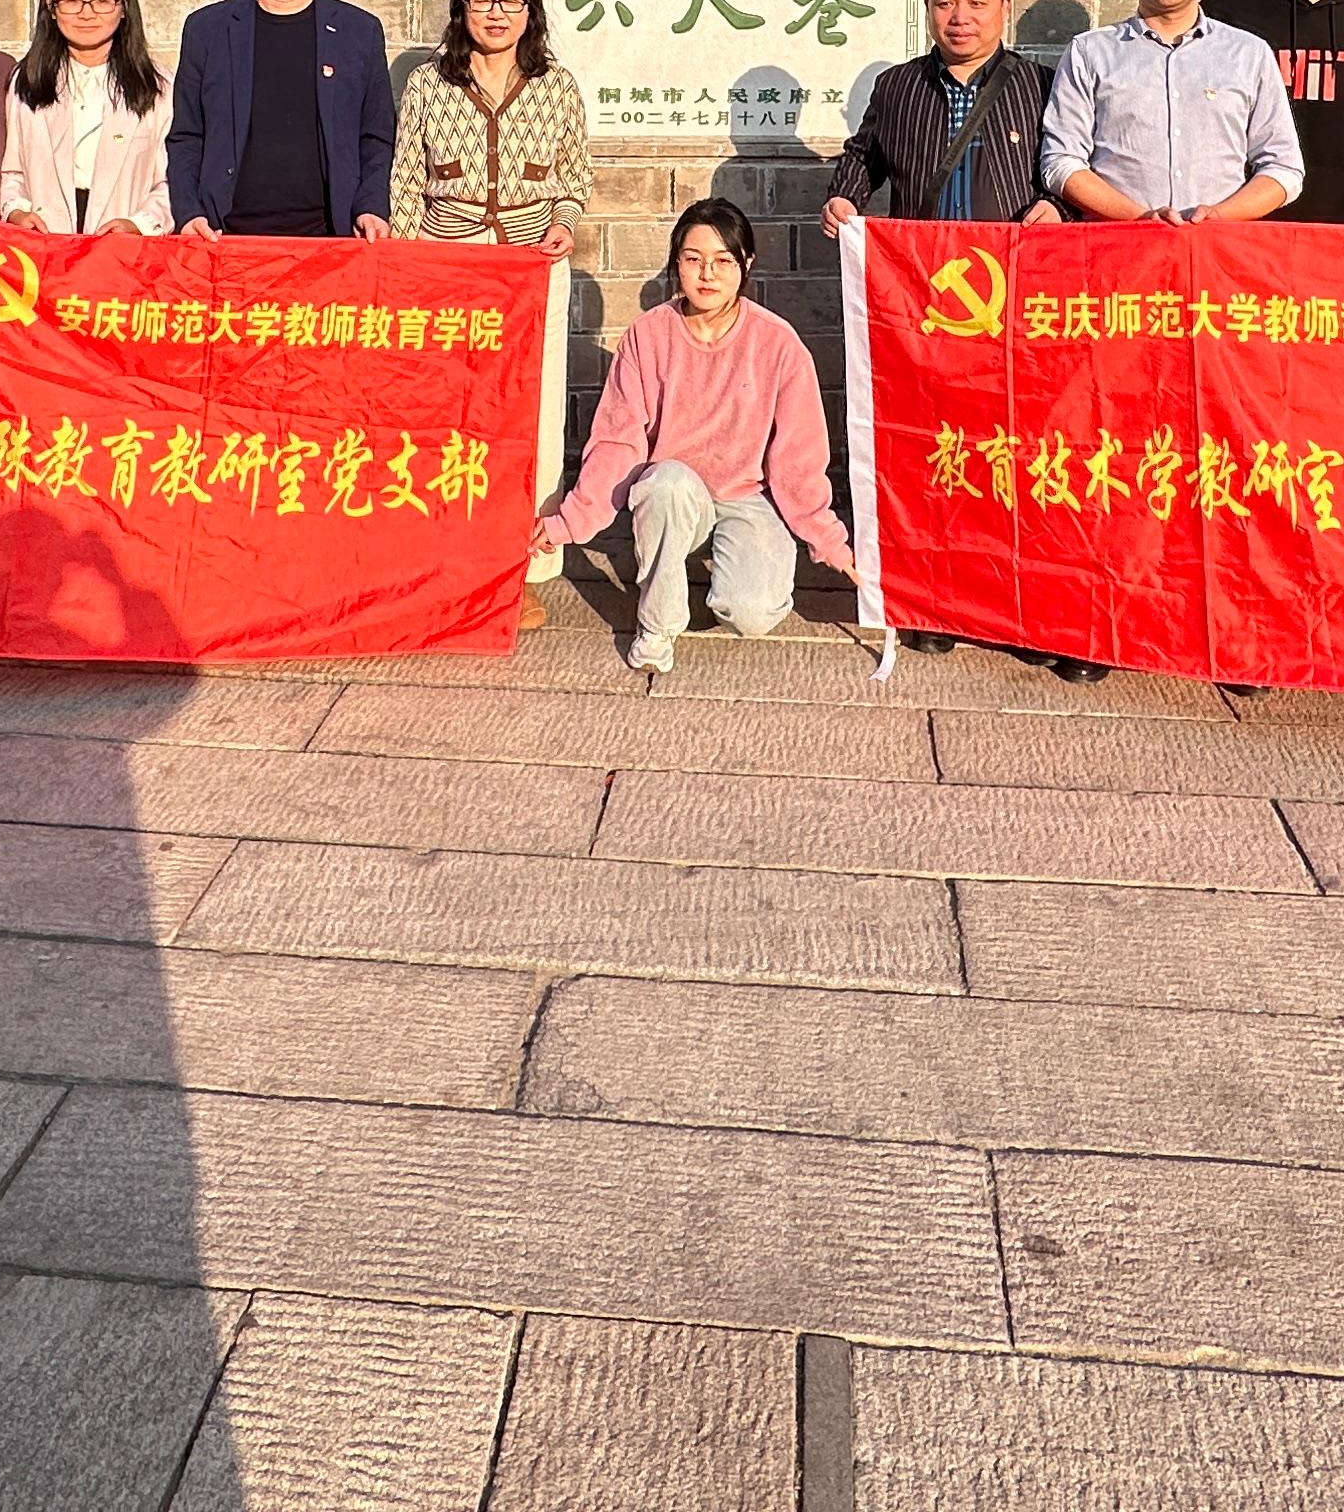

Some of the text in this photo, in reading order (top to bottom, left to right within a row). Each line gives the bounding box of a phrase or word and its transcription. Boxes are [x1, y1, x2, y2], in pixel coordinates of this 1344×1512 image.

[598, 87, 844, 104] 桐城市人民政府立
[56, 294, 504, 351] 安庆师范大学教师教育学院
